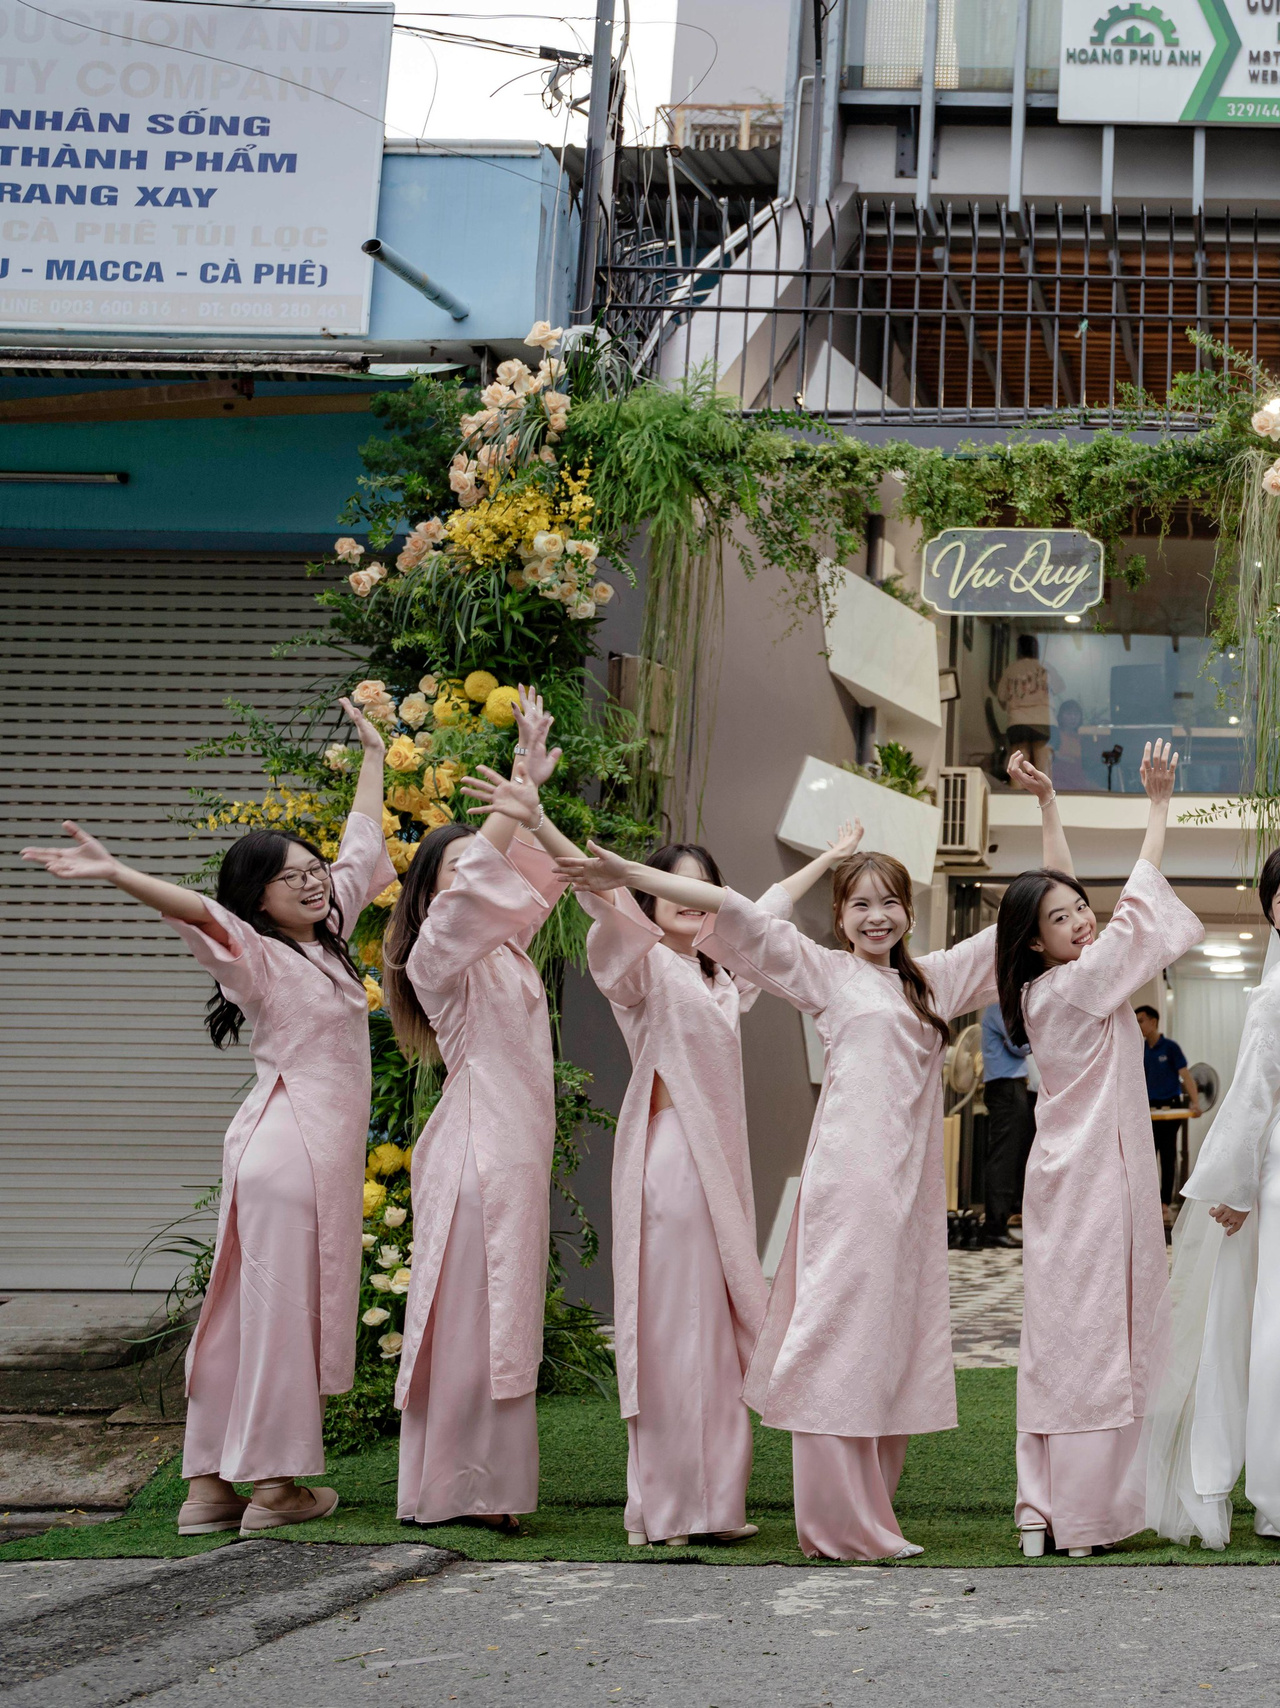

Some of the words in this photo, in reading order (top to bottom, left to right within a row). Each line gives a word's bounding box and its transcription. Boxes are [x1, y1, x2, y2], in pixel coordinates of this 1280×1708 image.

[0, 7, 218, 52] UCTION
[237, 17, 350, 53] AND
[1066, 48, 1123, 65] HOANG
[1129, 49, 1162, 66] PHU
[1167, 50, 1201, 66] ANH
[76, 60, 347, 104] COMPANY
[0, 107, 130, 133] NHÂN
[146, 107, 271, 137] SỐNG
[1227, 103, 1280, 117] 329/44
[0, 143, 148, 170] THÀNH
[164, 143, 298, 173] PHẨM
[0, 182, 119, 206] RANG
[134, 186, 219, 208] XAY
[75, 219, 157, 246] PHÊ
[250, 226, 329, 252] LỌC
[46, 260, 164, 283] MACCA
[199, 258, 242, 284] CÀ
[253, 260, 328, 288] PHÊ)
[50, 299, 94, 315] 0903
[100, 300, 133, 315] 600
[138, 301, 171, 316] 816
[230, 303, 273, 318] 0908
[278, 303, 311, 318] 280
[932, 541, 1007, 599] Vu
